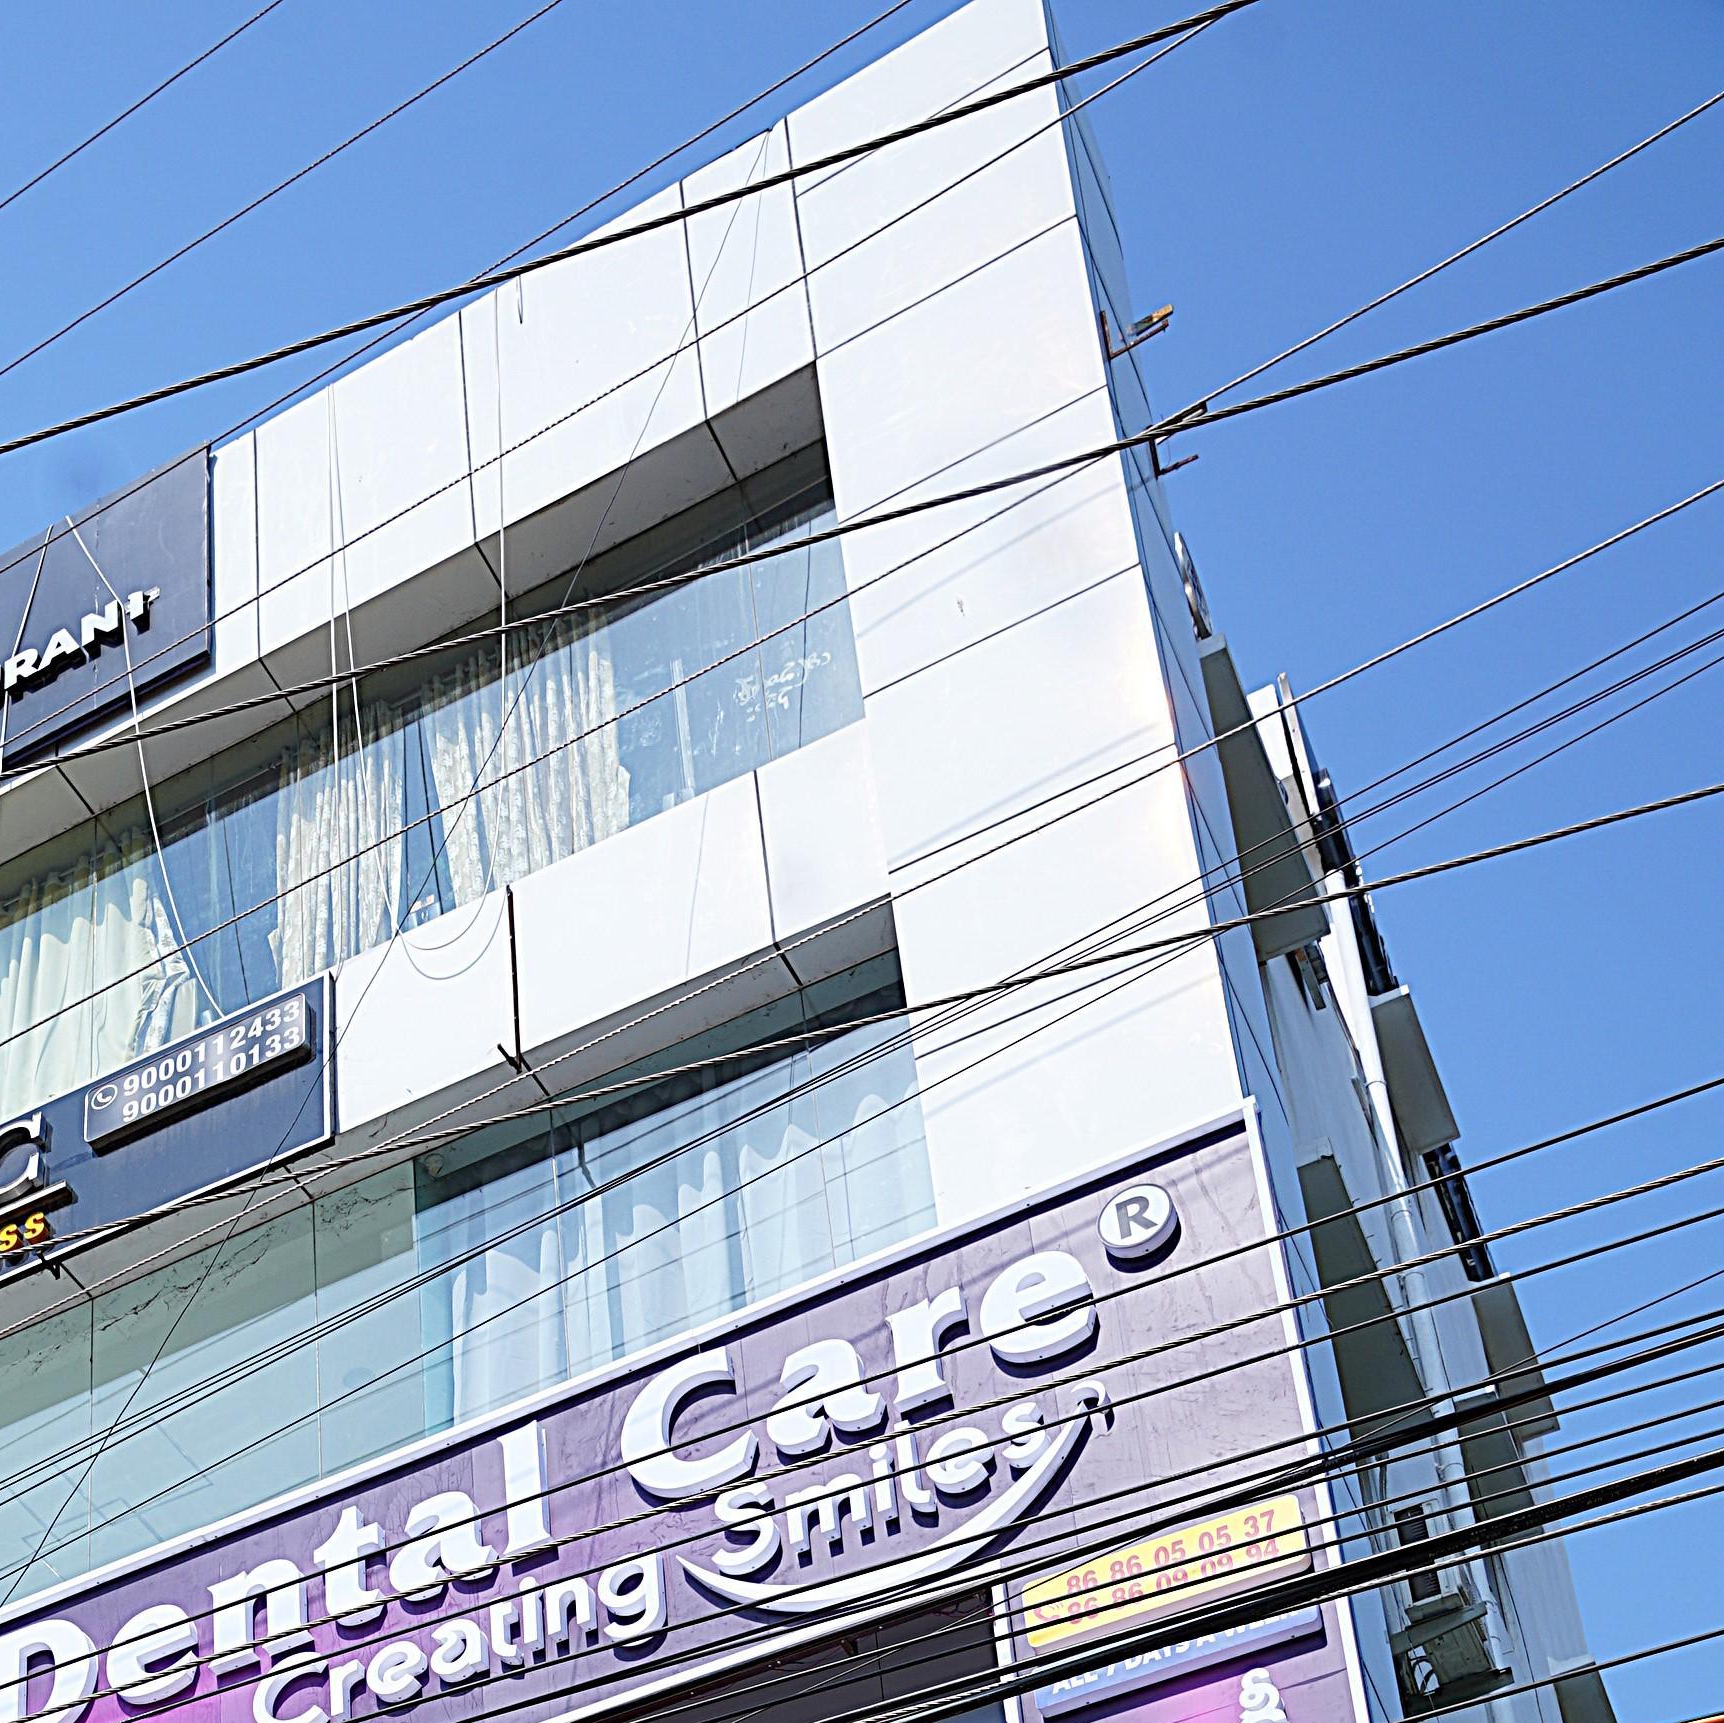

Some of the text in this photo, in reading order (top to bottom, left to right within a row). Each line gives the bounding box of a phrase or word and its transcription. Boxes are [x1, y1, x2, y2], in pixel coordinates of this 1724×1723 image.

[123, 1000, 300, 1097] 9000112433
[123, 1026, 300, 1122] 9000110133
[621, 1243, 1098, 1503] Care
[714, 1405, 1046, 1576] Smiles
[1066, 1509, 1275, 1596] 86 86 05 05 37
